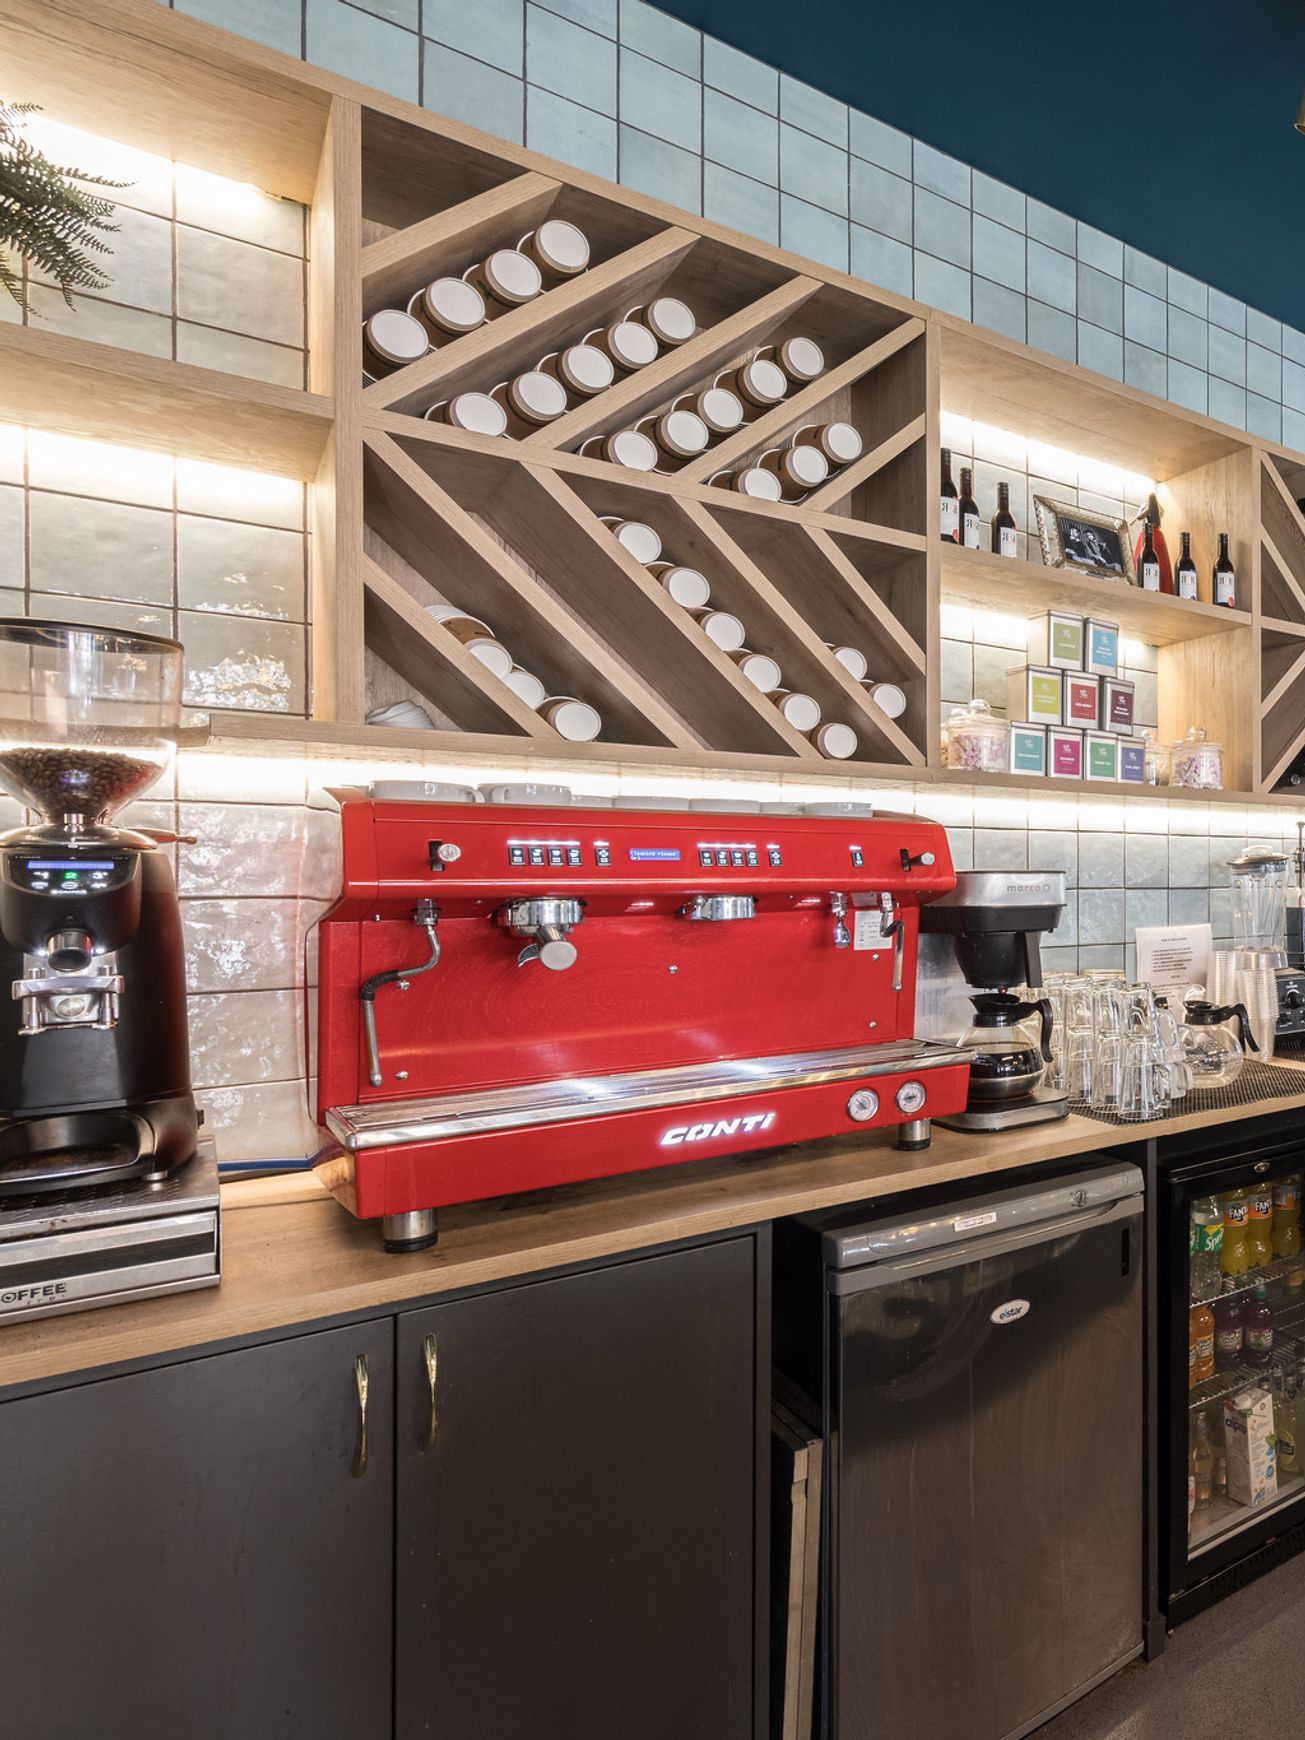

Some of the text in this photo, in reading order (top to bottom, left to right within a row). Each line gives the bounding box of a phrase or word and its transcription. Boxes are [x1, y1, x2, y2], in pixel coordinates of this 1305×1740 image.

[1007, 884, 1040, 892] marco
[660, 1112, 775, 1145] CONTI
[0, 1283, 67, 1303] OFFEE
